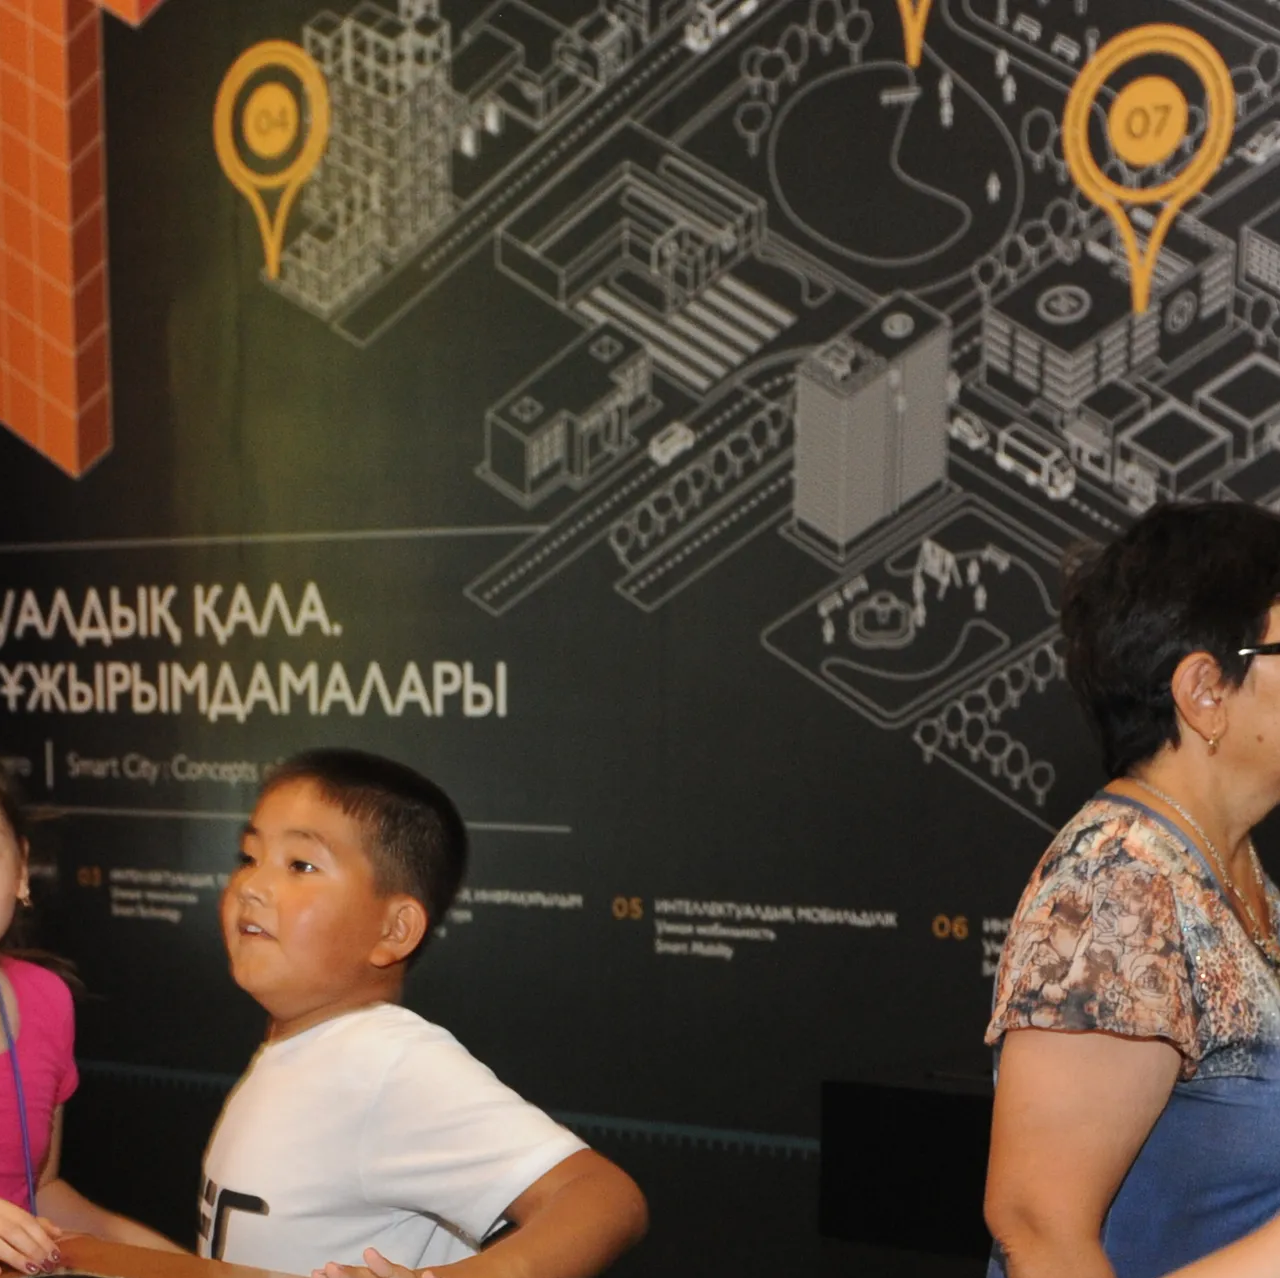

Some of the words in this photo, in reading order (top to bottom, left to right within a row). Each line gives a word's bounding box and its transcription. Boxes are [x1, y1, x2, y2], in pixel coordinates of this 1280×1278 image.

[1125, 103, 1172, 140] 07
[194, 581, 343, 647] ҚАЛА.
[66, 751, 119, 779] Smart
[171, 753, 259, 788] Concepts
[611, 896, 644, 920] 05
[931, 914, 969, 940] 06
